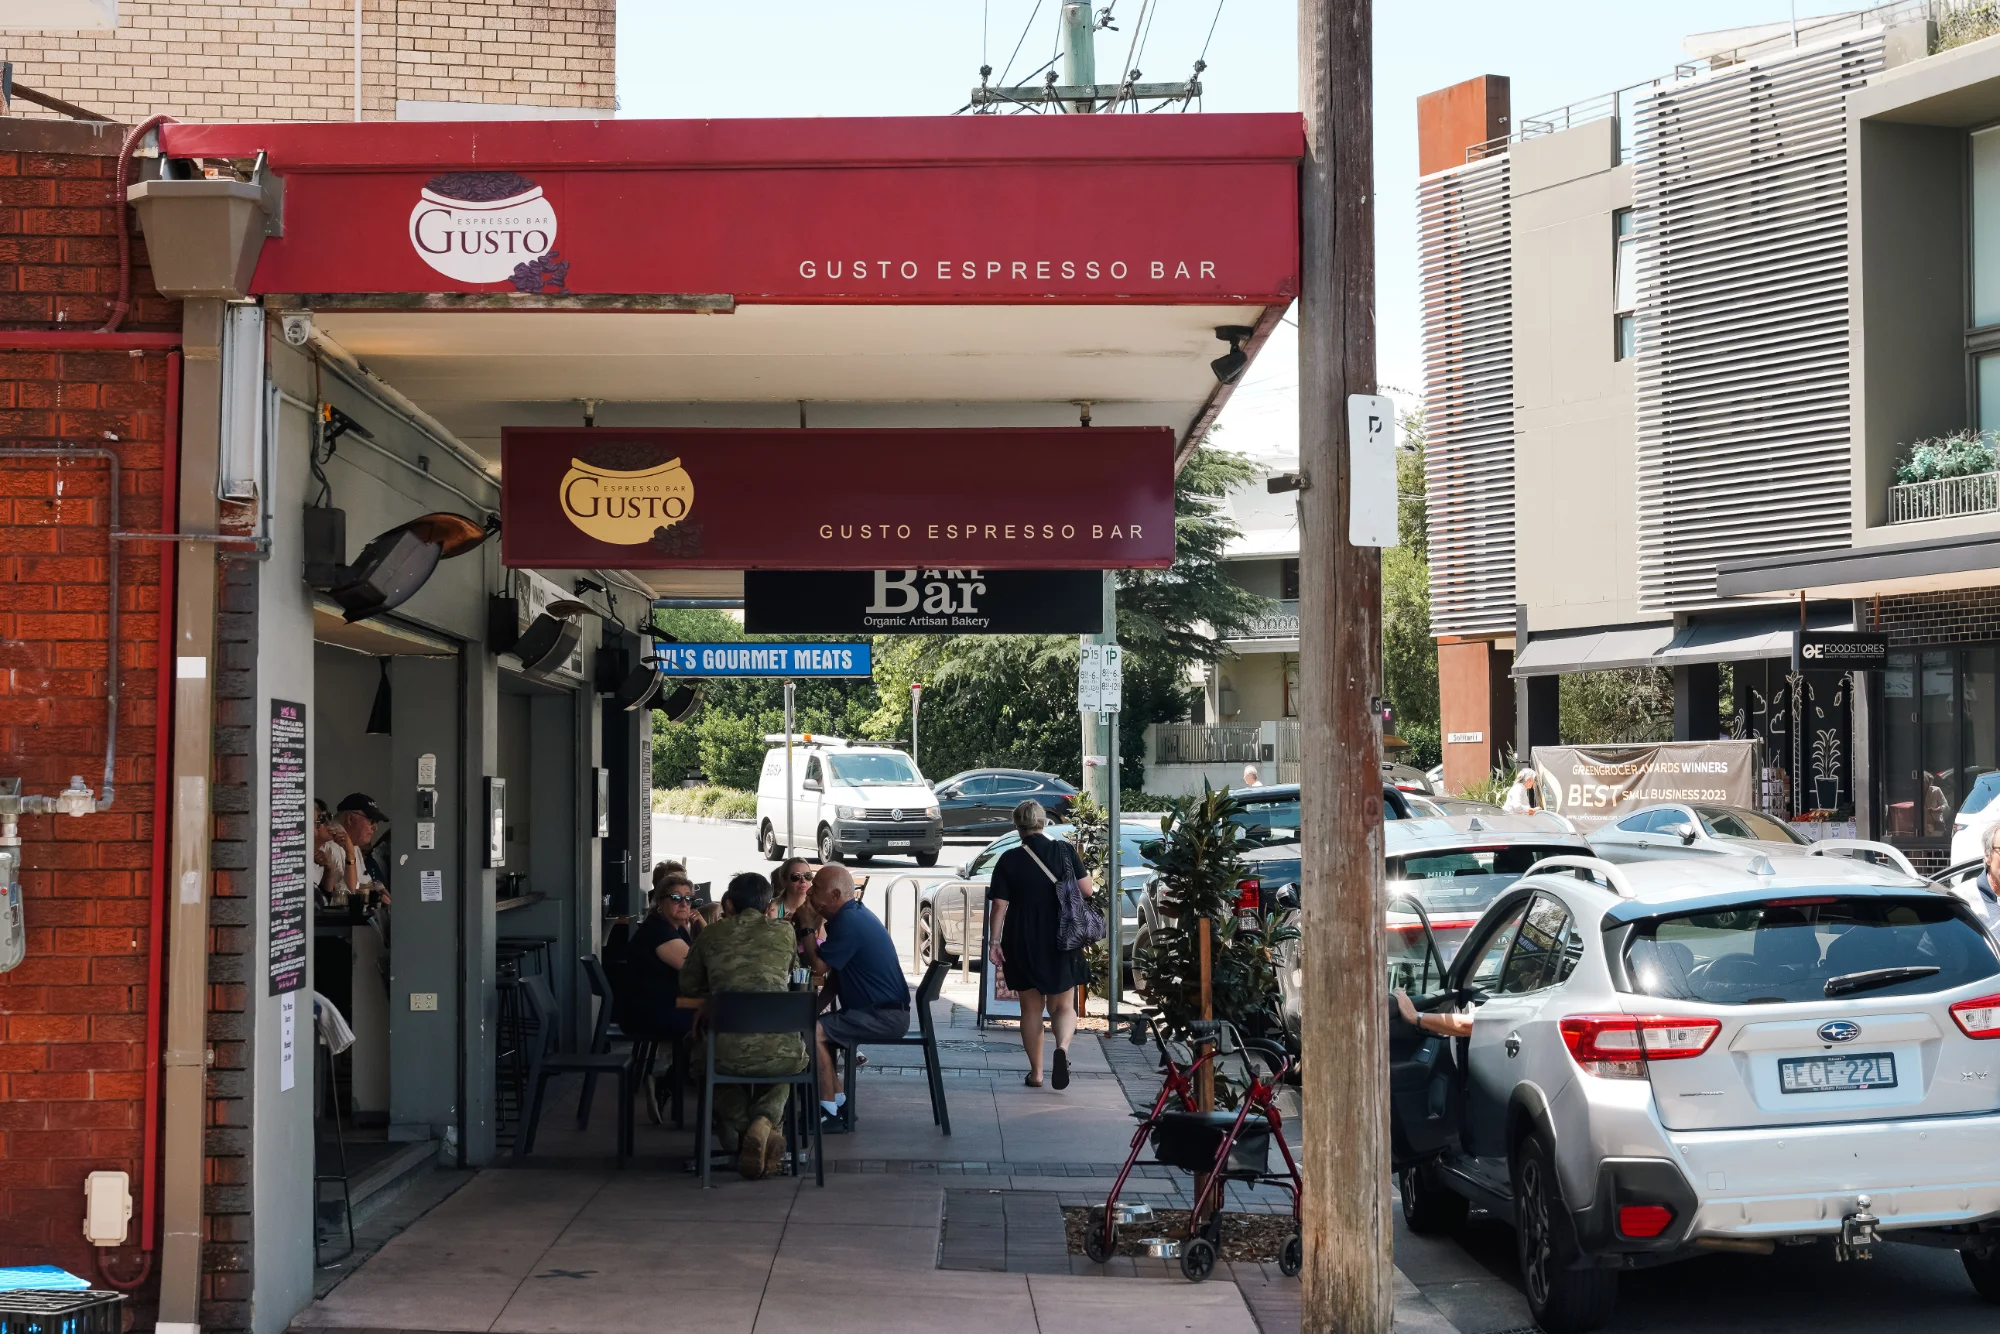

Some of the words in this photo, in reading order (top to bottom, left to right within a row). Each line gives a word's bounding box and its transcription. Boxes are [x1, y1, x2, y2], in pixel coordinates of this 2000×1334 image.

[457, 217, 520, 226] ESPRESSO
[526, 217, 549, 225] BAR
[414, 209, 549, 255] GUSTO
[799, 260, 919, 280] GUSTO
[937, 260, 1128, 280] ESPRESSO
[1150, 260, 1217, 280] BAR
[564, 476, 686, 519] GUSTO
[819, 524, 911, 540] GUSTO
[927, 524, 1076, 540] ESPRESSO
[1092, 524, 1144, 540] BAR
[865, 570, 987, 614] Bar
[863, 616, 906, 628] Organic
[909, 616, 948, 626] Artisan
[951, 616, 990, 628] Bakery
[1825, 644, 1884, 653] FOODSTORES
[702, 649, 788, 670] GOURMET
[794, 649, 853, 670] MEATS
[1081, 649, 1089, 665] P
[1091, 650, 1098, 659] 15
[1106, 650, 1117, 665] 1P
[1572, 764, 1638, 776] GREENGROCER
[1638, 762, 1680, 774] AWARDS
[1681, 761, 1728, 774] WINNERS
[1567, 784, 1624, 808] BEST
[1622, 789, 1650, 801] SMALL
[1650, 789, 1700, 801] BUSINESS
[1701, 789, 1727, 801] 2023
